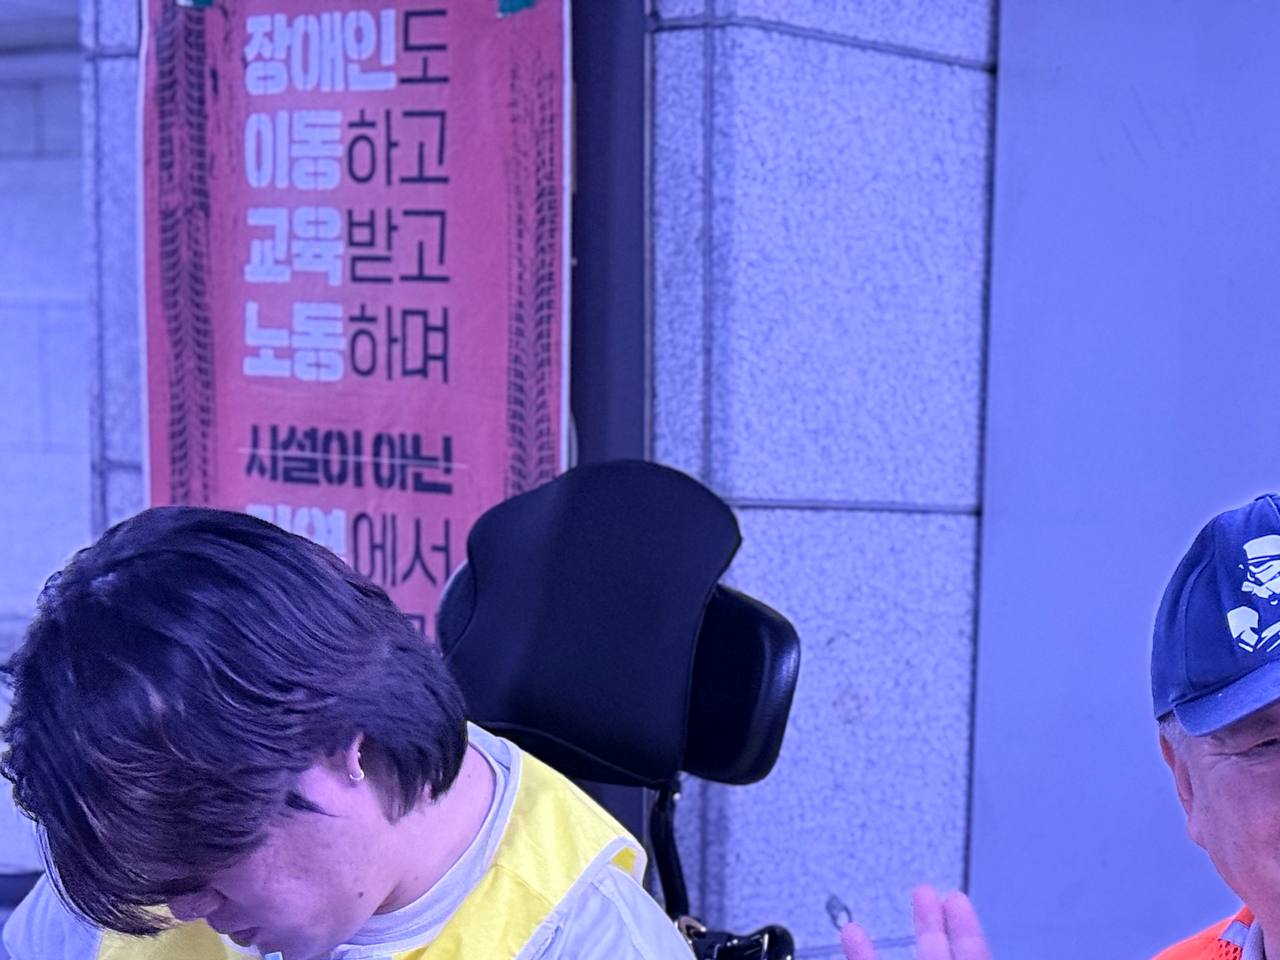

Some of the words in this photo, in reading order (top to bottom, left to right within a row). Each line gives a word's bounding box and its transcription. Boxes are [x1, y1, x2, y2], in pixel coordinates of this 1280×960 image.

[242, 8, 450, 95] 장애인도
[242, 108, 451, 191] 이동하고
[242, 205, 451, 287] 교육받고
[242, 299, 450, 384] 노동하며
[244, 423, 363, 488] 시설이
[372, 427, 454, 495] 아닌
